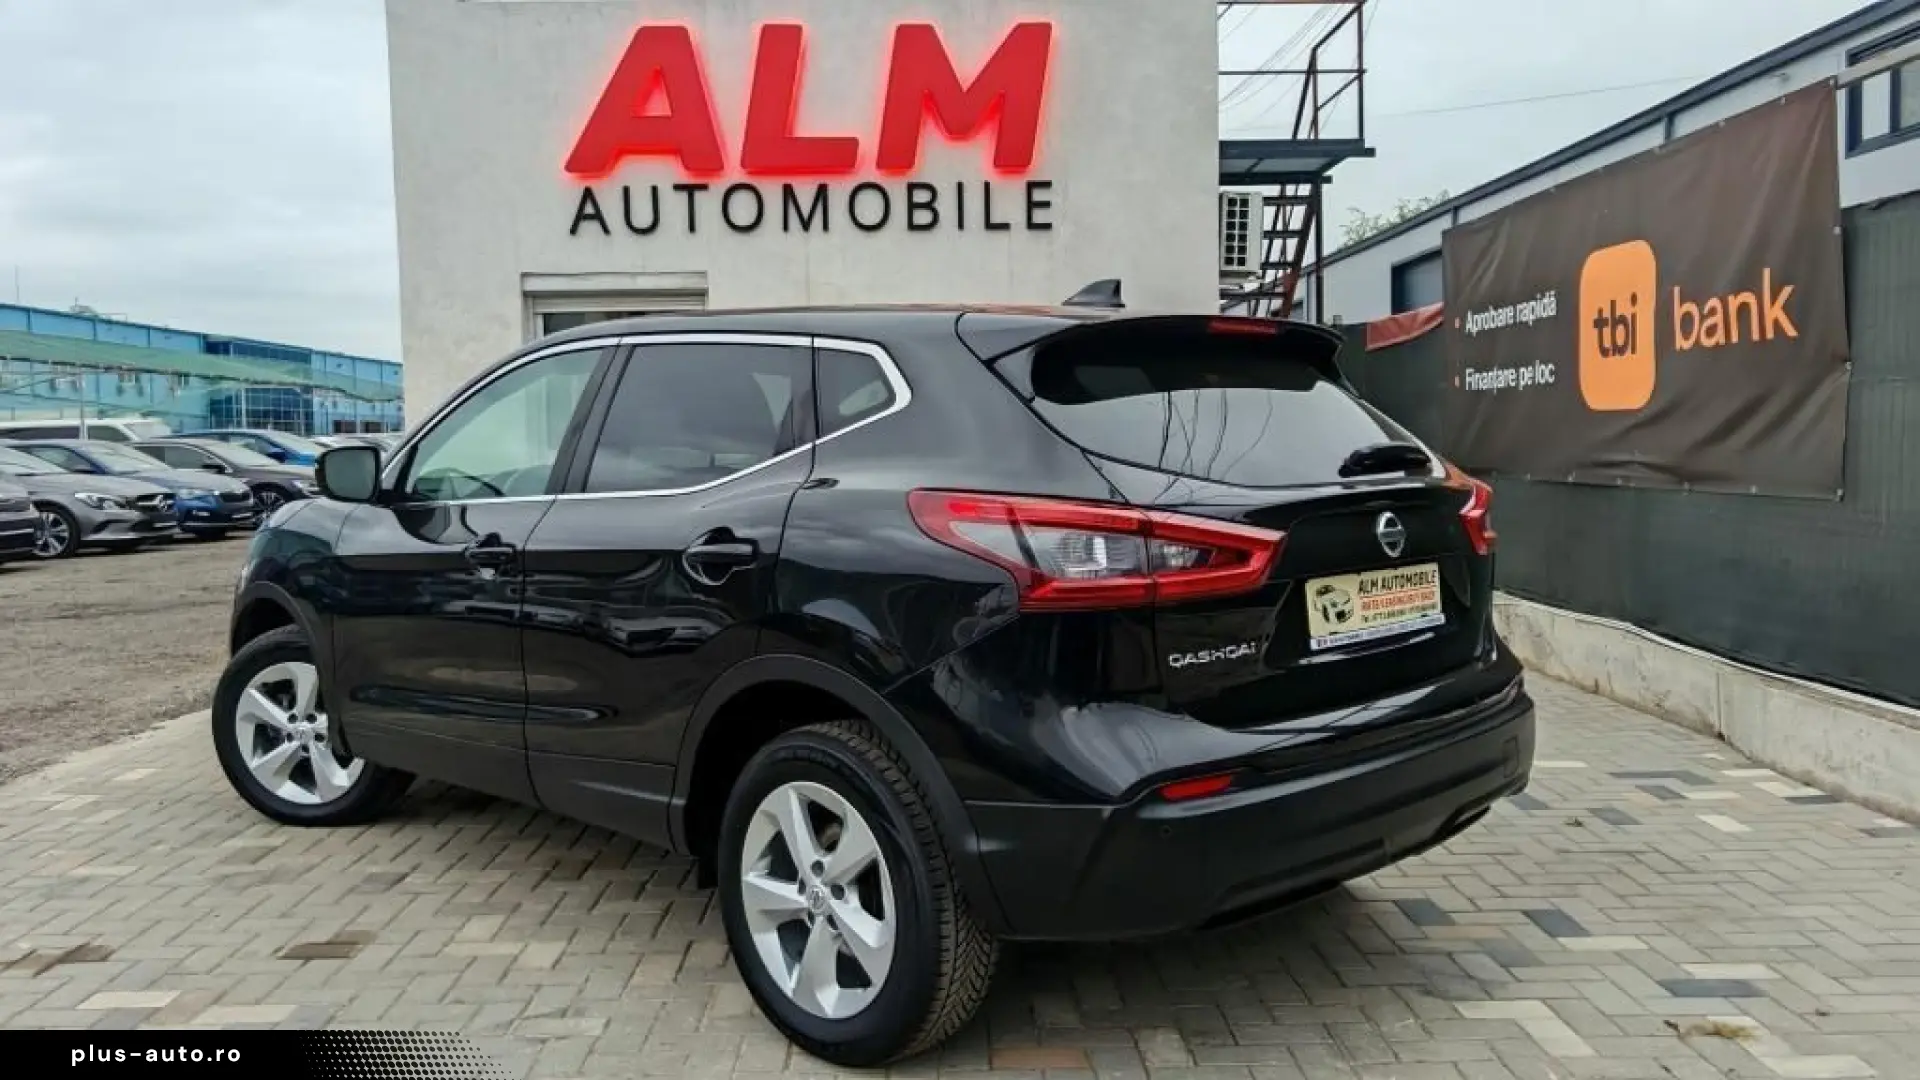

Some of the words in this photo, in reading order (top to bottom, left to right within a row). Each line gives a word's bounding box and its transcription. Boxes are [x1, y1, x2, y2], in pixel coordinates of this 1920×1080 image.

[564, 21, 1053, 174] ALM
[569, 180, 1054, 236] AUTOMOBILE
[1465, 305, 1514, 337] Aprobare
[1516, 290, 1557, 326] rapidă
[1592, 291, 1639, 359] tbi
[1673, 267, 1800, 352] bank
[1519, 365, 1534, 390] pe
[1535, 359, 1556, 384] loc
[1358, 577, 1379, 594] ALM
[1381, 569, 1437, 591] AUTOMOBILE
[1168, 641, 1257, 668] QASHQAI
